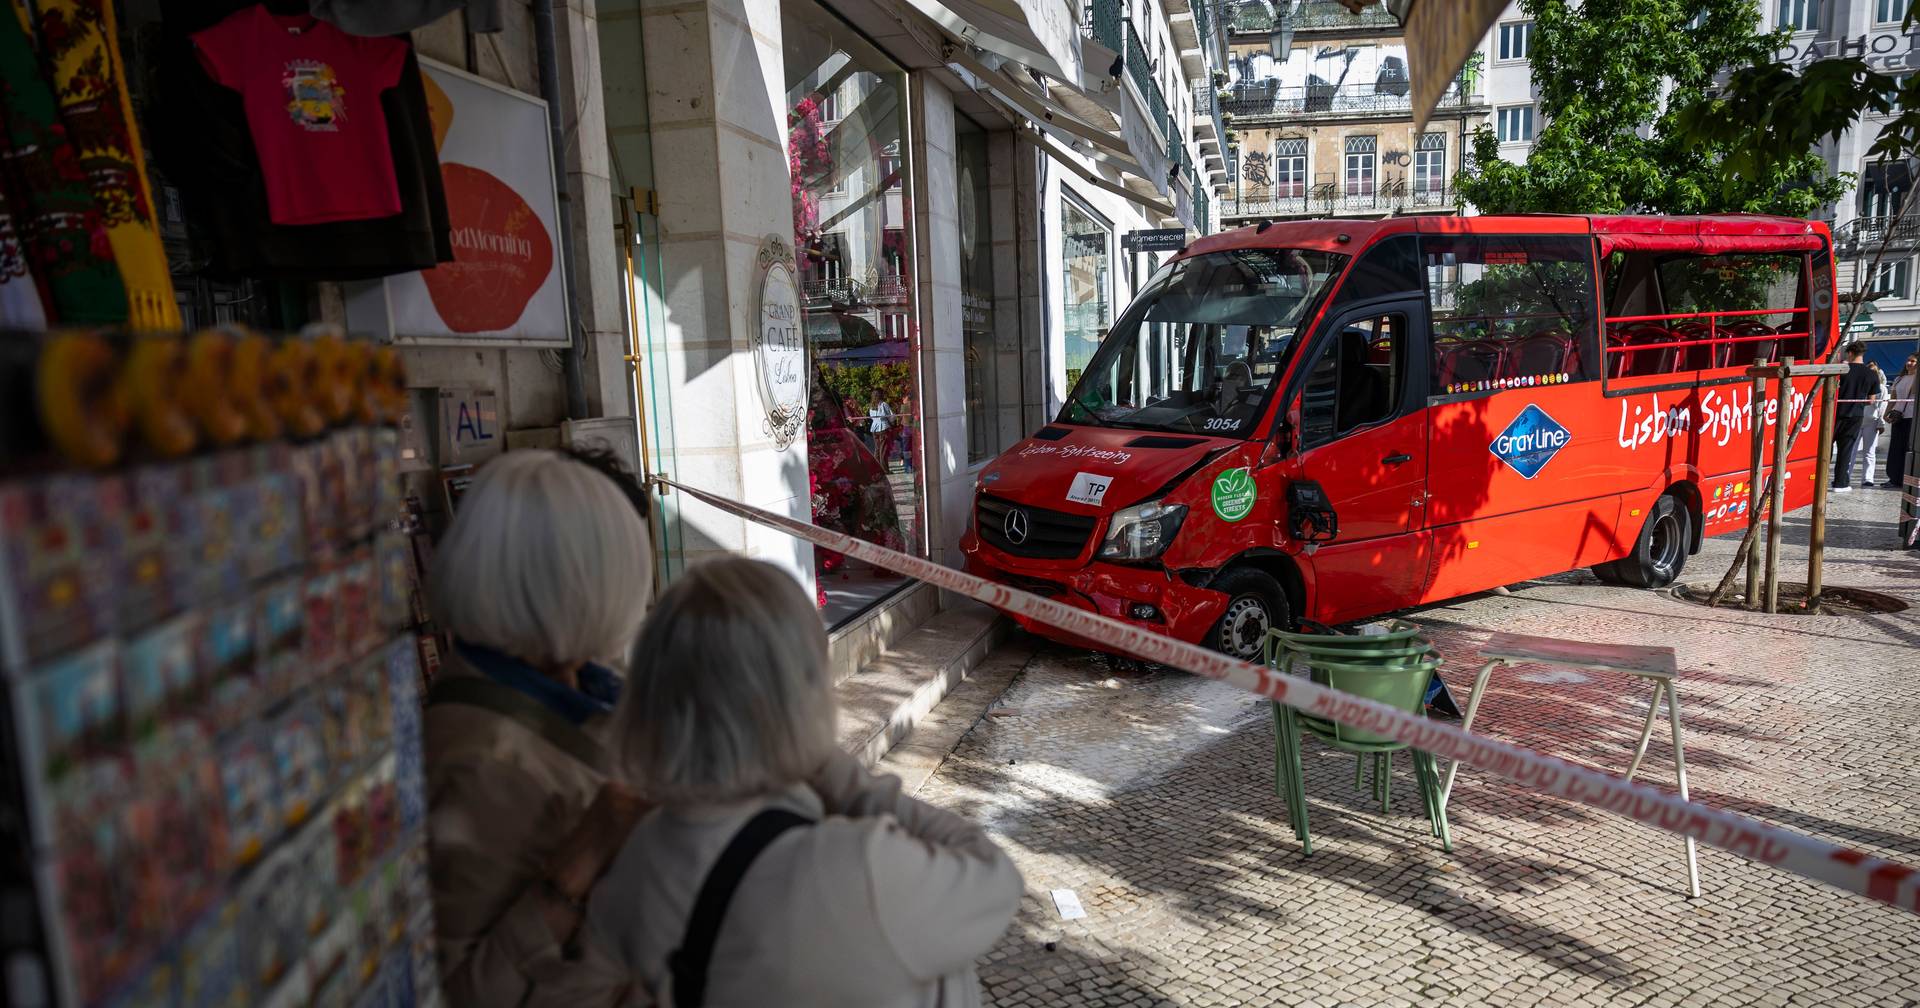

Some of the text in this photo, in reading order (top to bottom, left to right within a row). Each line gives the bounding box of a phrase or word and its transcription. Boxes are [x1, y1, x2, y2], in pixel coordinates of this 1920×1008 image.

[1774, 41, 1825, 62] DA
[449, 227, 532, 262] odMorning
[767, 303, 796, 321] GRAND
[1203, 417, 1242, 431] 3054
[1618, 385, 1814, 451] Lisbon Sighteing
[1018, 443, 1132, 465] Lisbon Sightseeing
[1089, 482, 1106, 496] TP
